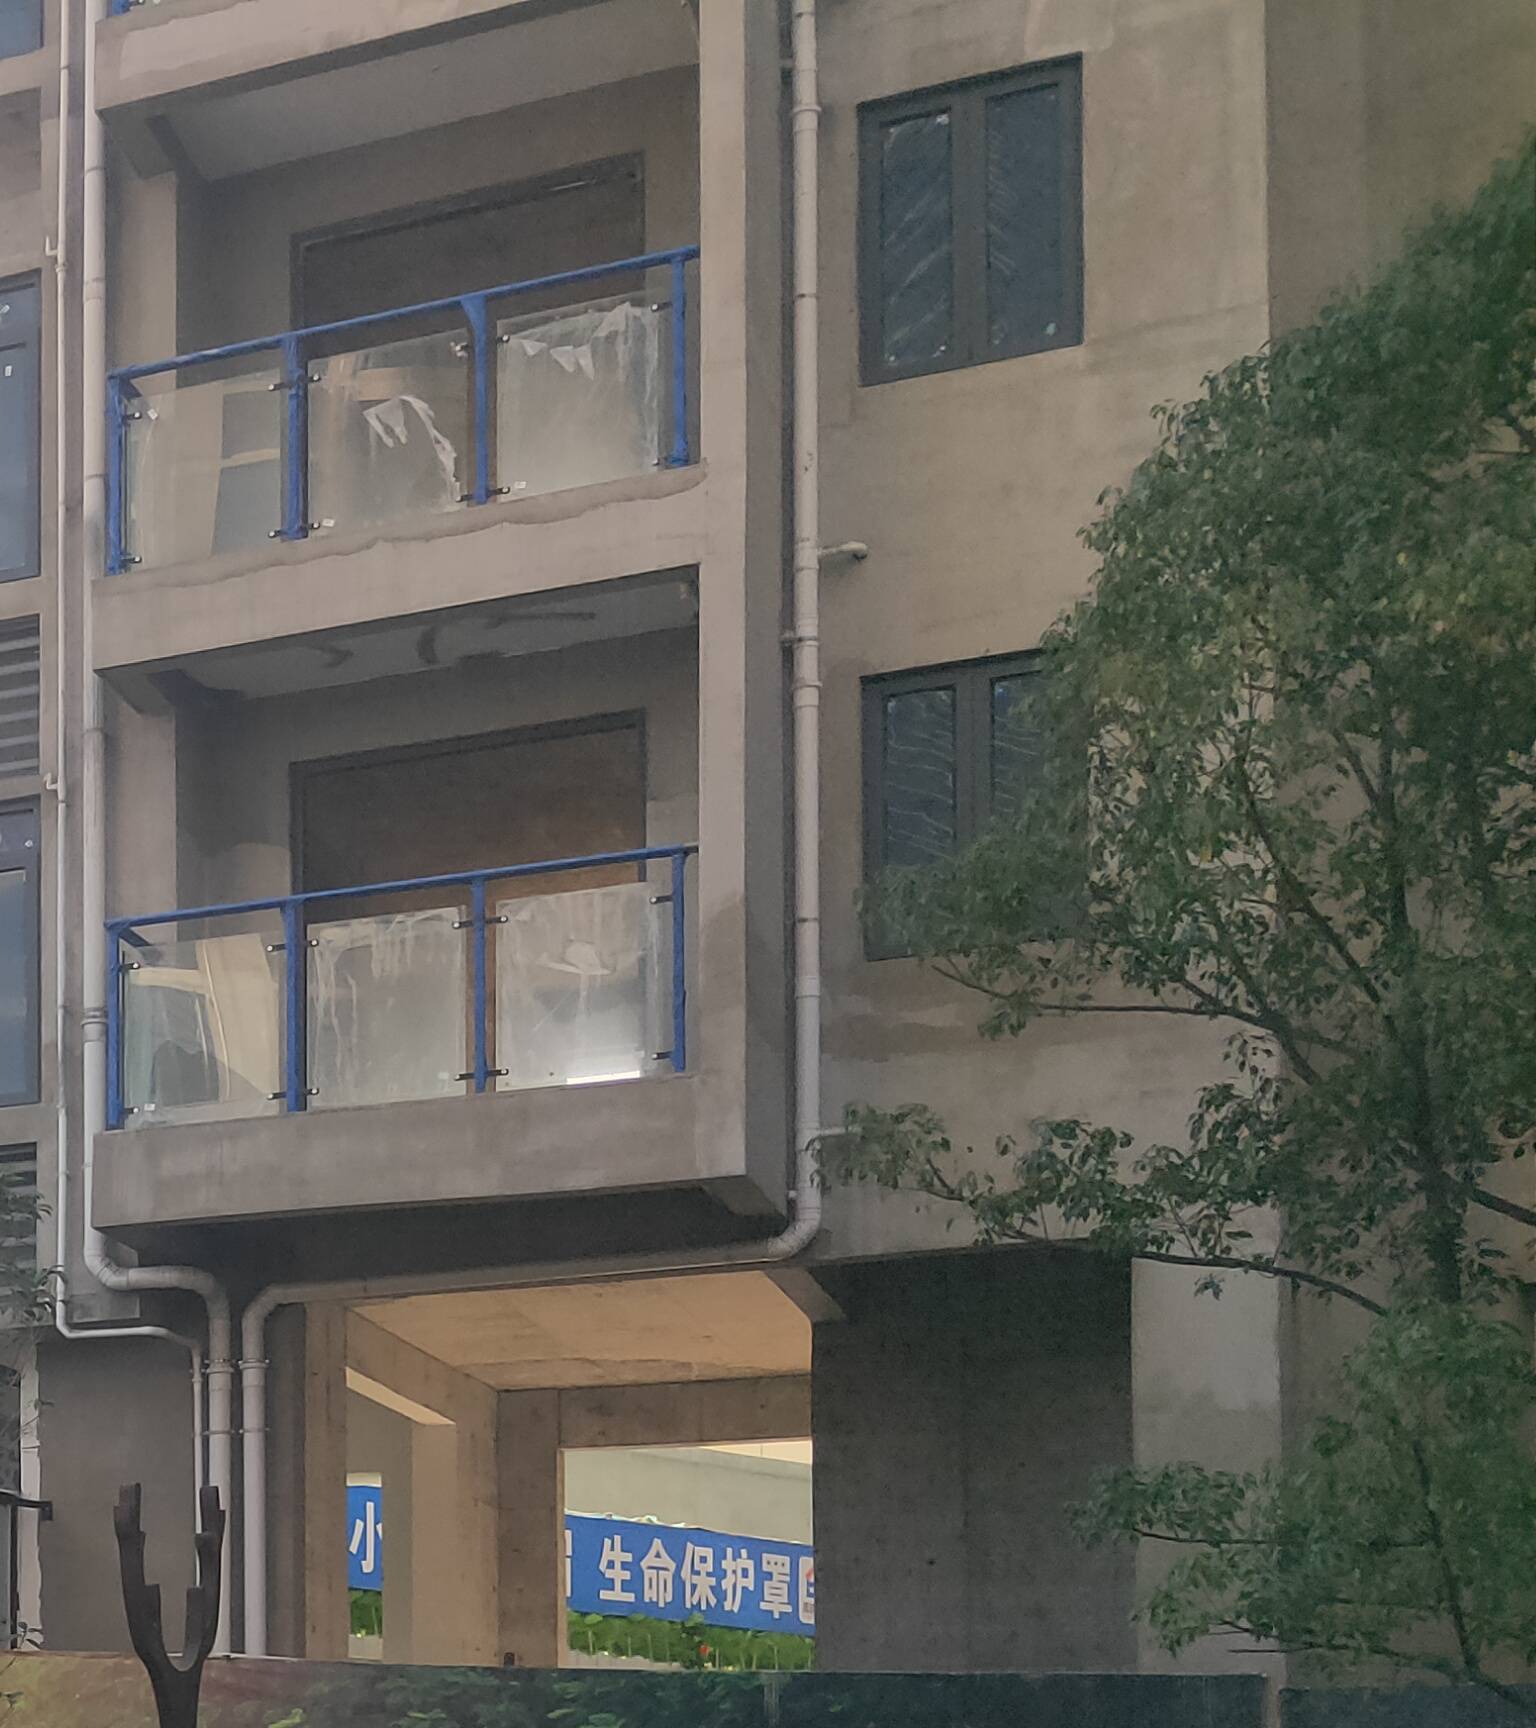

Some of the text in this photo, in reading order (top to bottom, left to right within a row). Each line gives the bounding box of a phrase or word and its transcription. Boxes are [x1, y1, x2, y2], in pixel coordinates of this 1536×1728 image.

[599, 1534, 793, 1620] 生命保护罩
